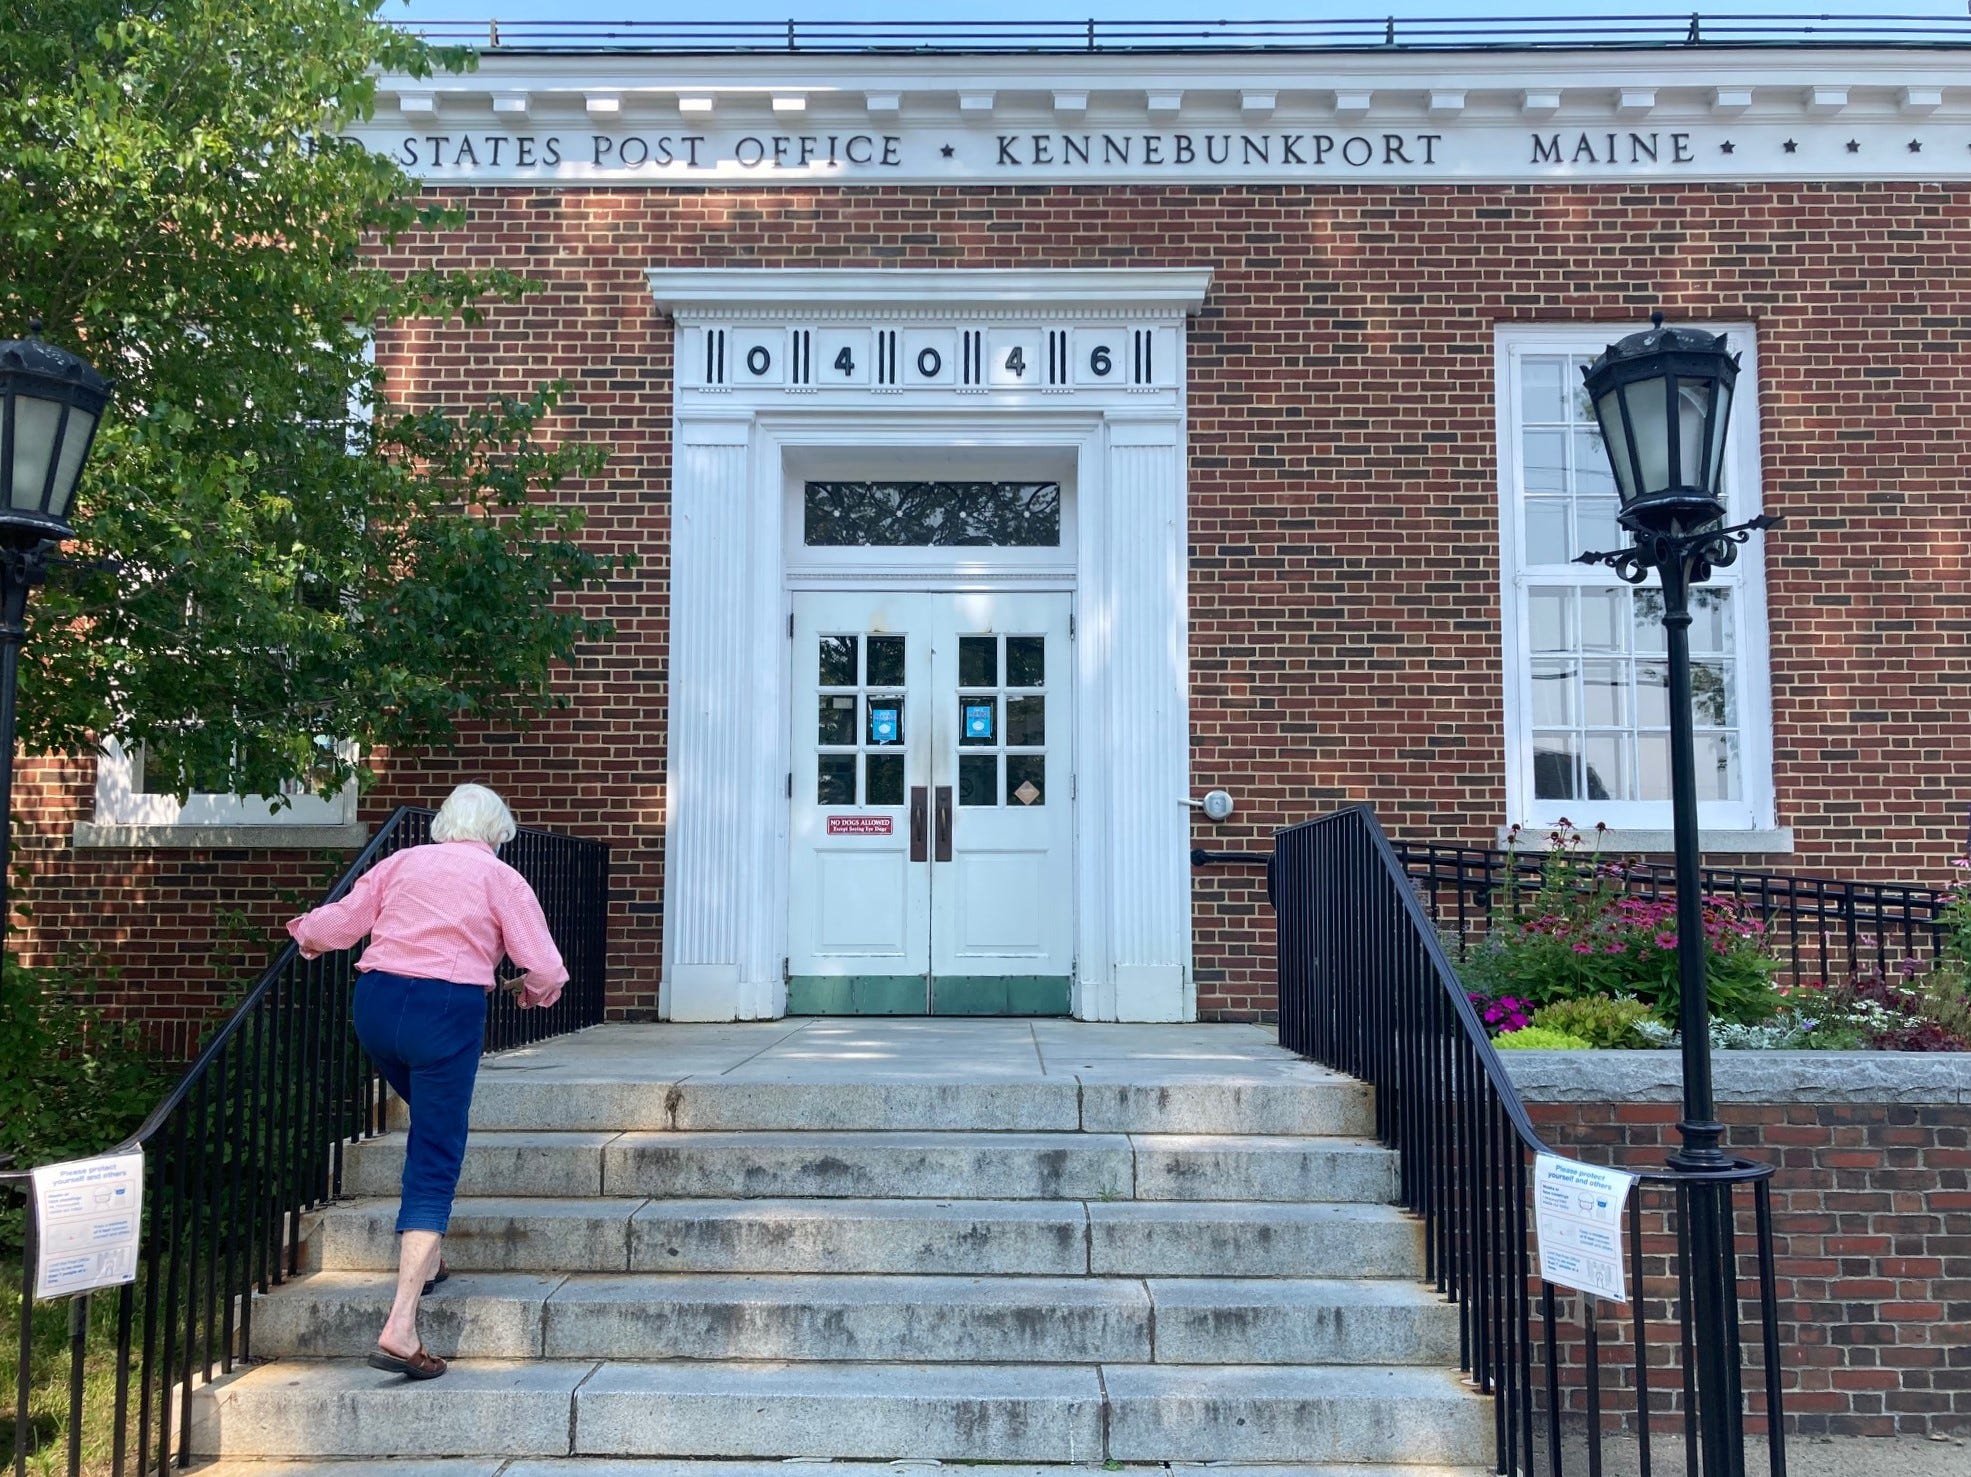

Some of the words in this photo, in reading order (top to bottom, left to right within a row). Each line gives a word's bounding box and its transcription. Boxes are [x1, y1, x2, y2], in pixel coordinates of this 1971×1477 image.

[400, 134, 560, 167] STATES
[591, 135, 704, 168] POST
[735, 135, 901, 168] OFFICE
[996, 134, 1441, 167] KENNEBUNKPORT
[1530, 132, 1694, 164] MAINE
[86, 1173, 102, 1181] and
[103, 1170, 127, 1179] others
[88, 1165, 117, 1174] protect
[1555, 1164, 1579, 1175] Please
[1578, 1170, 1605, 1182] protect
[1548, 1172, 1574, 1183] yourself
[1574, 1177, 1589, 1186] and
[1589, 1180, 1612, 1191] others
